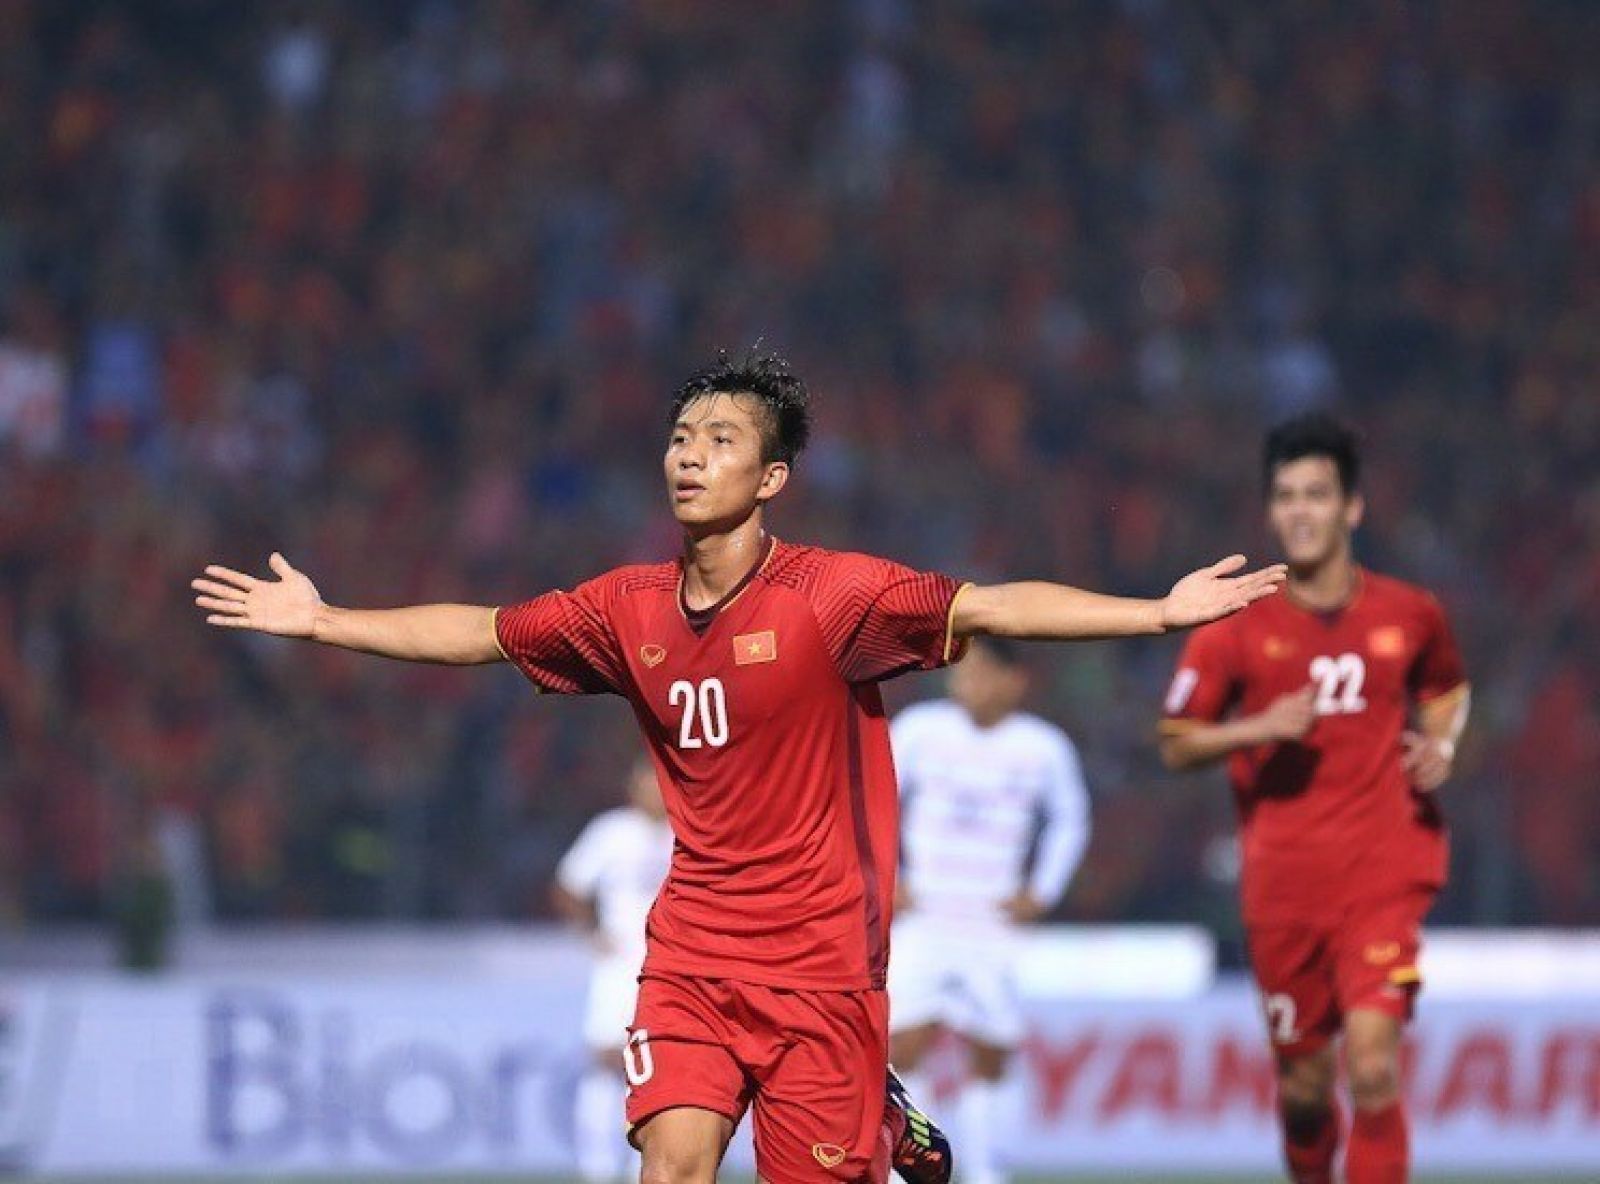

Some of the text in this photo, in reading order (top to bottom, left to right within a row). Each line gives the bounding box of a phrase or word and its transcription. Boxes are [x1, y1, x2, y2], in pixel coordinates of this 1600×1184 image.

[668, 677, 729, 749] 20
[1309, 652, 1367, 716] 22
[1022, 1022, 1600, 1126] YANAR
